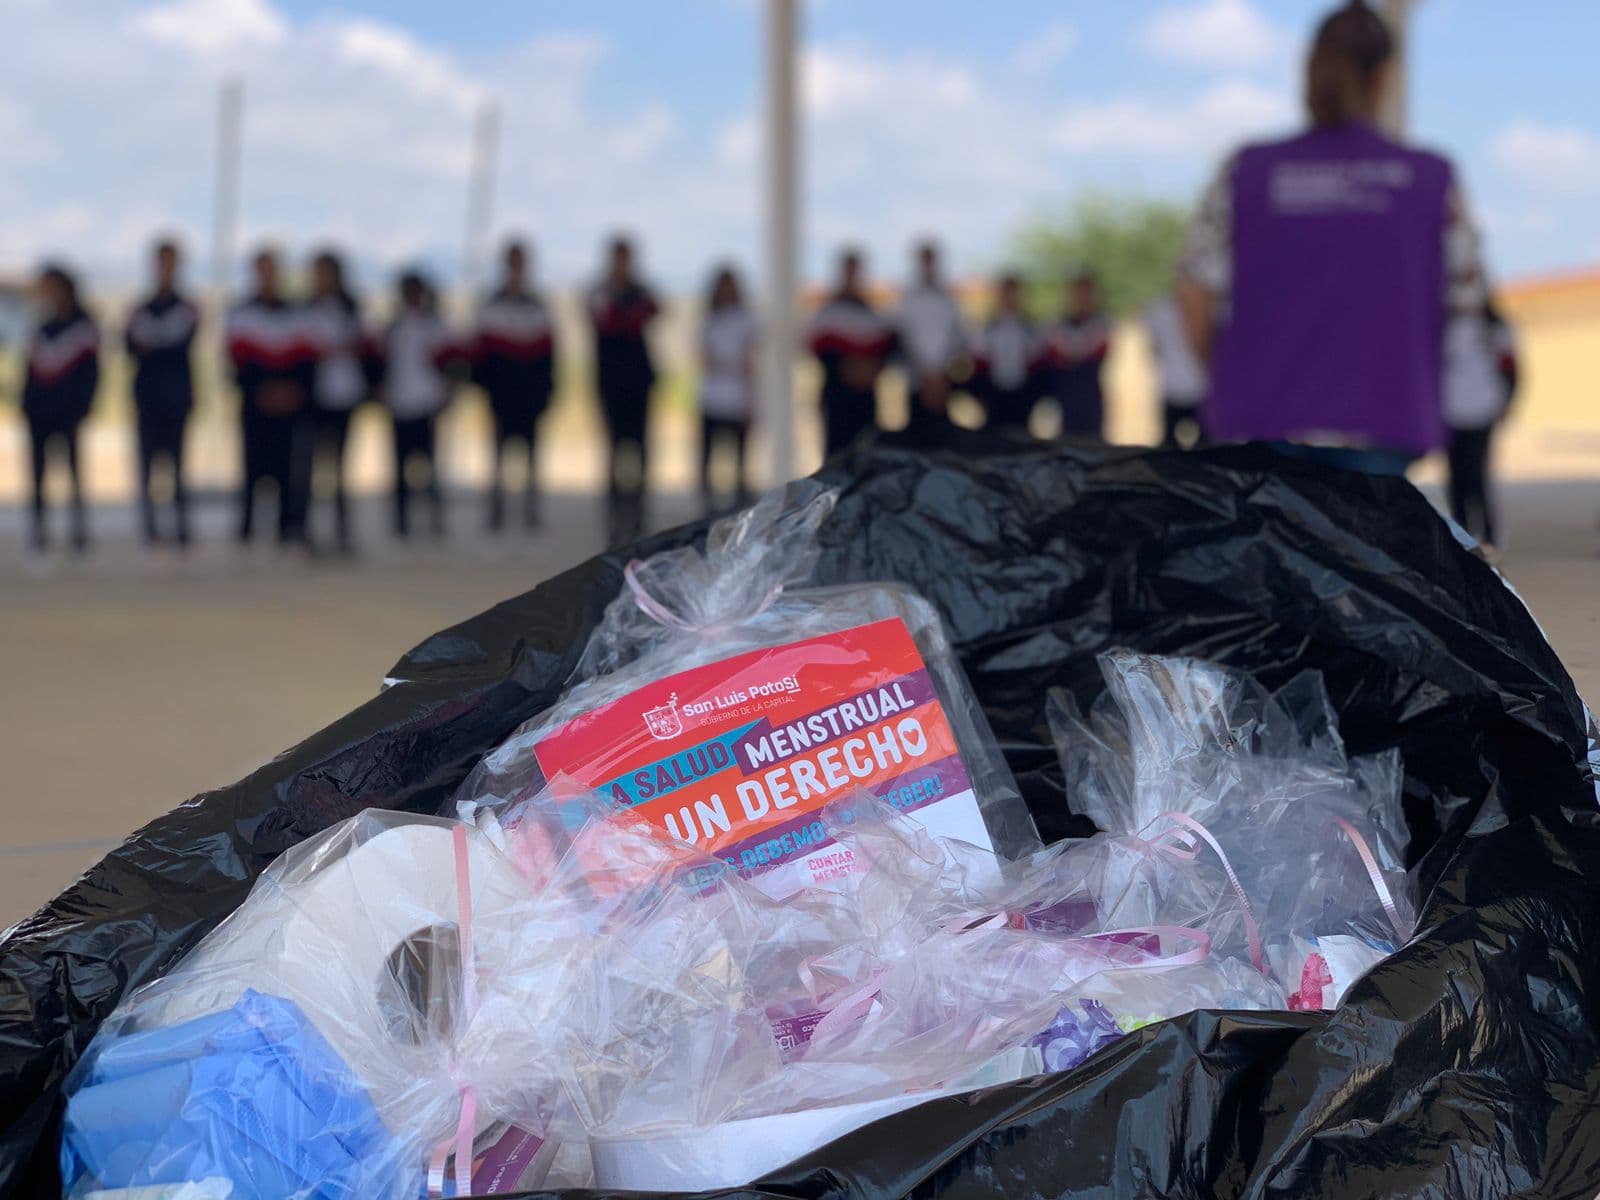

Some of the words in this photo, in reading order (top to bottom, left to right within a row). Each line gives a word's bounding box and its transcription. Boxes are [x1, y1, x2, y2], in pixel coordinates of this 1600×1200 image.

[682, 701, 714, 718] San
[715, 690, 748, 709] Luis
[700, 708, 739, 727] GOBIERNO
[740, 705, 752, 716] DE
[753, 703, 764, 713] LA
[764, 695, 795, 710] CAPITAL
[634, 741, 730, 799] SALUD
[744, 682, 915, 769] MENSTRUAL
[664, 794, 731, 846] UN
[735, 717, 928, 821] DERECHO
[741, 821, 827, 869] DEBEMO
